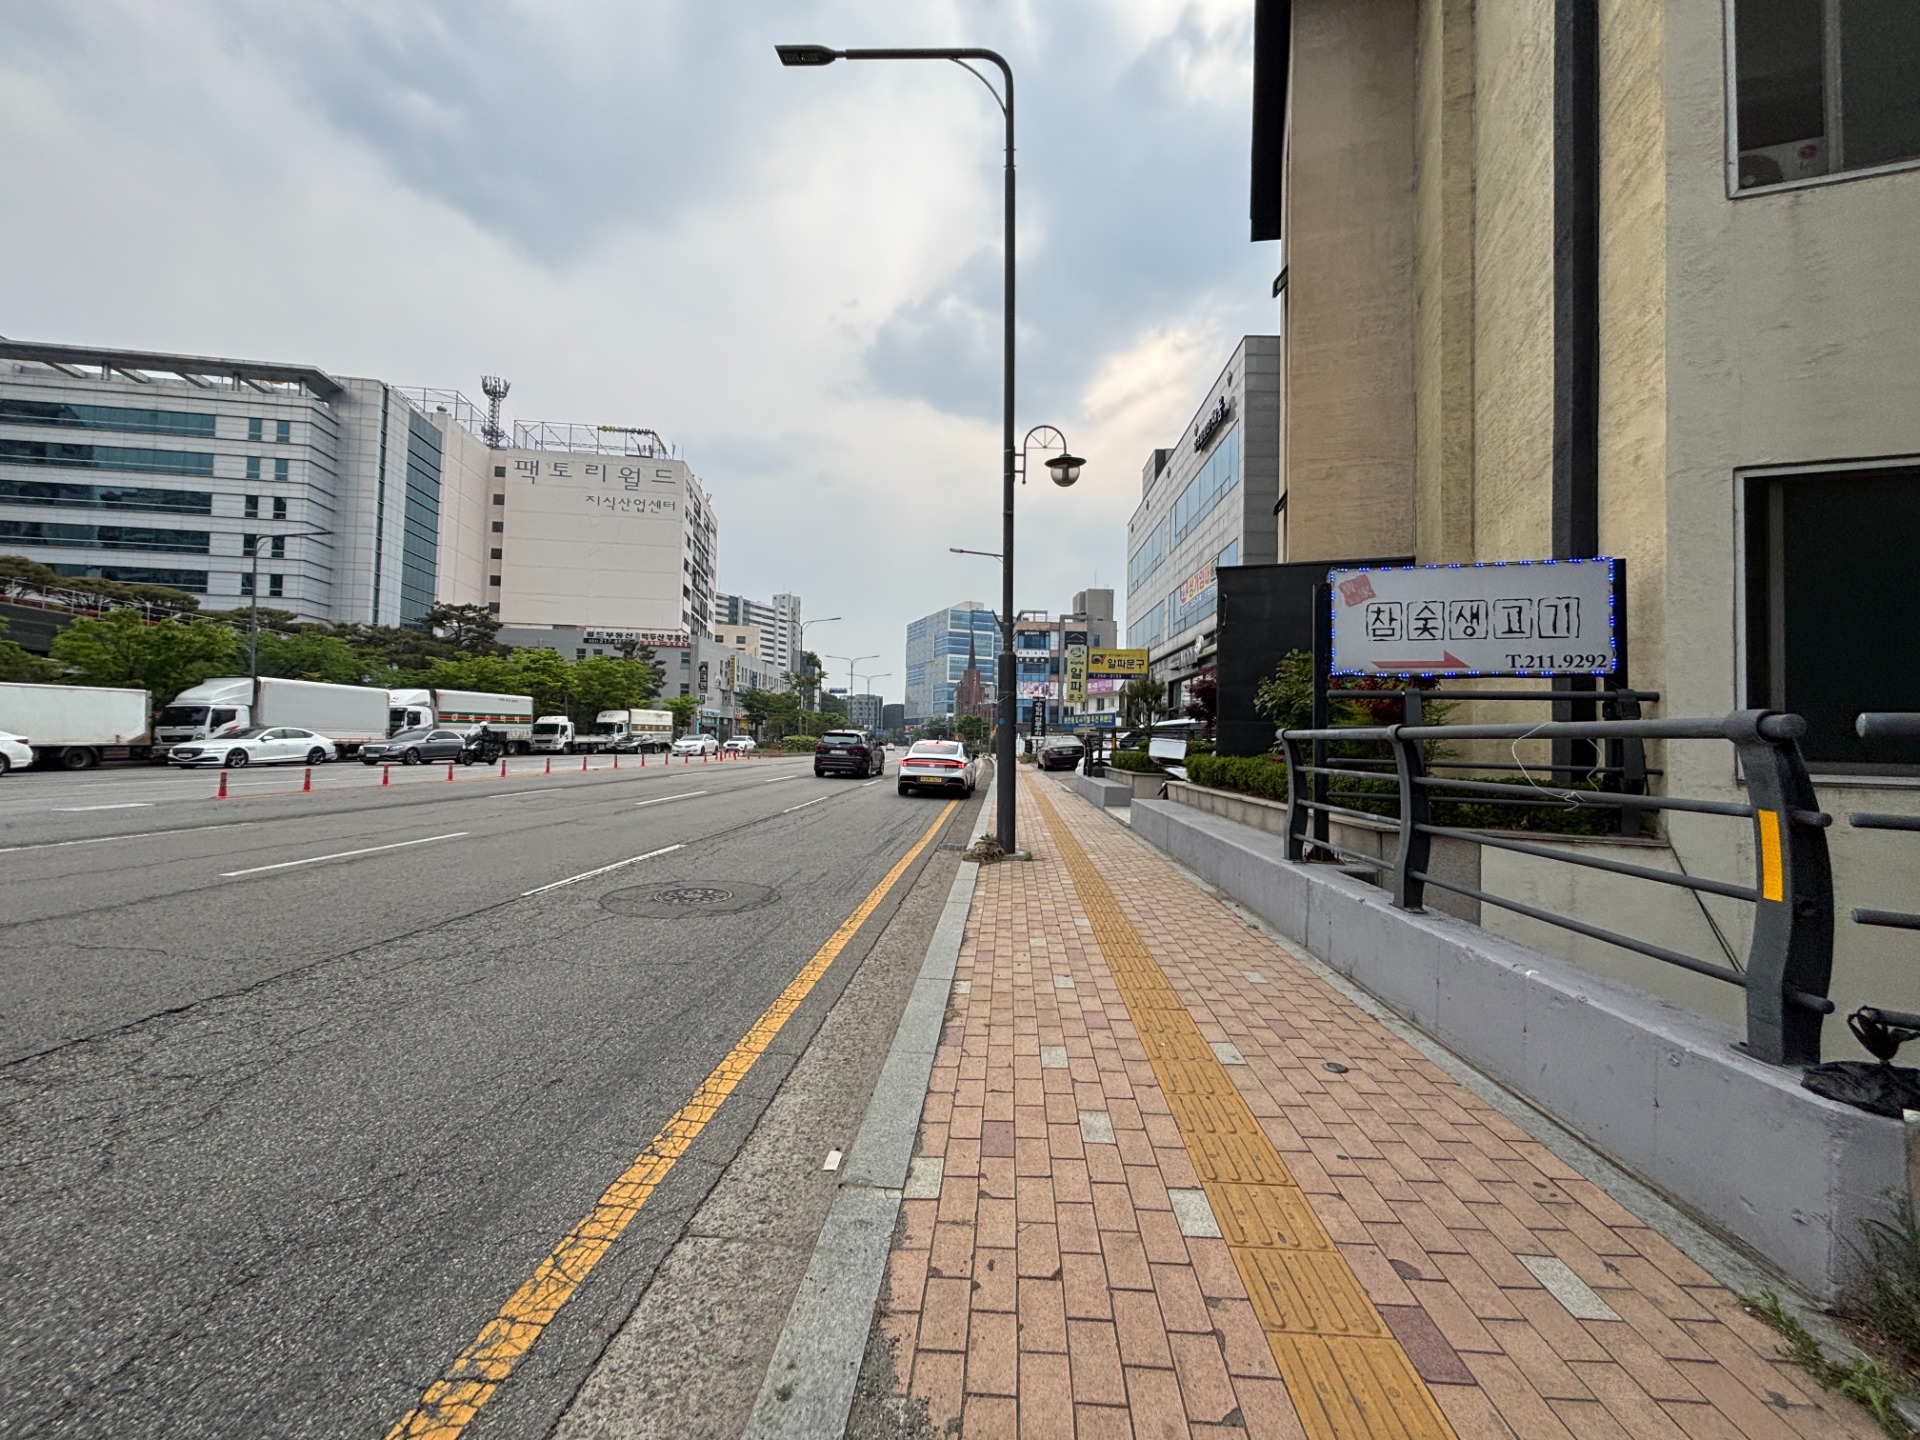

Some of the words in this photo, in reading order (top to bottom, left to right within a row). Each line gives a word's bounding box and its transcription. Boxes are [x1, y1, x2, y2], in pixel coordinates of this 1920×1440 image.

[514, 459, 676, 491] 팩토리월드
[584, 495, 676, 514] 지식산업센터
[1107, 658, 1145, 669] 알파문구
[1505, 653, 1608, 669] T.211.9292
[1070, 667, 1083, 693] 알파
